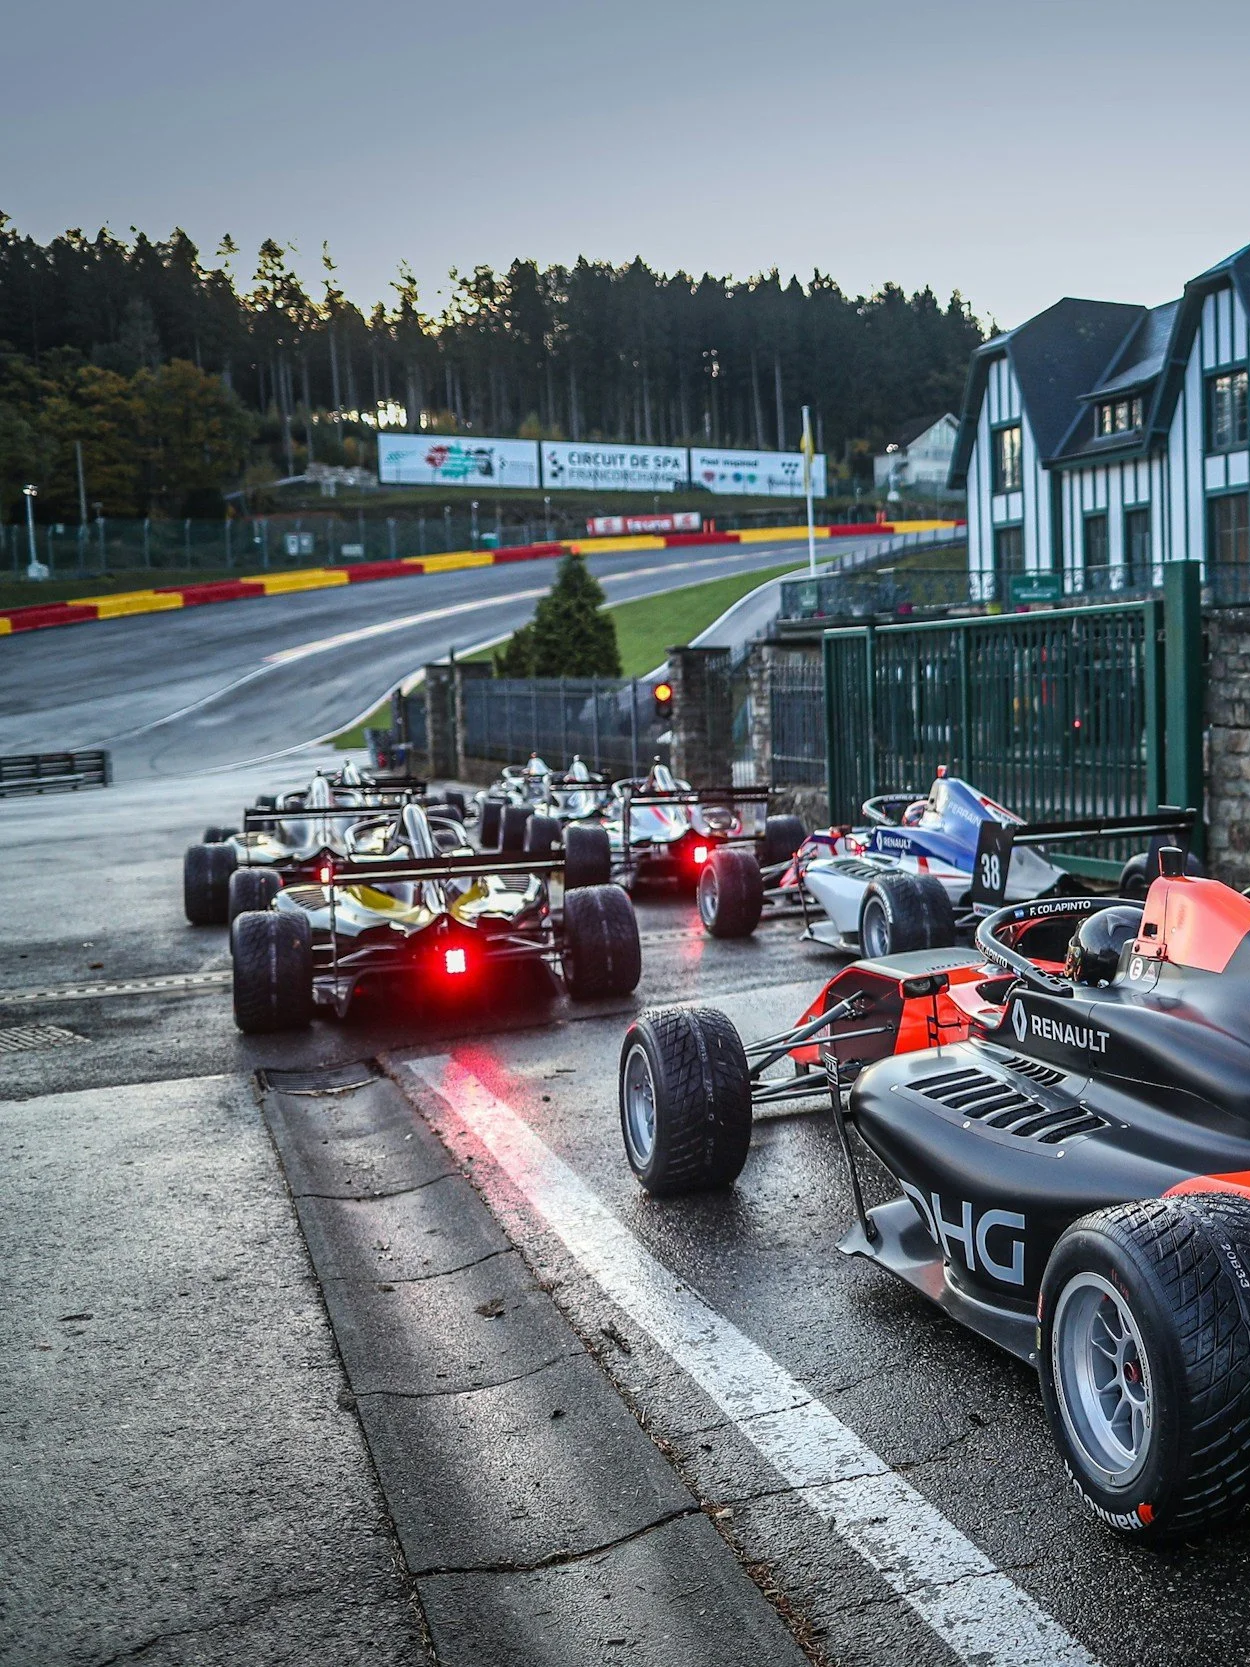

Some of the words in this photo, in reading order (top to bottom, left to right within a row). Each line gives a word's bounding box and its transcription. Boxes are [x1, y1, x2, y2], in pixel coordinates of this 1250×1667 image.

[568, 451, 626, 468] CIRCUIT
[630, 454, 650, 468] DE
[653, 455, 681, 470] SPA
[884, 836, 912, 850] RENAULT
[980, 852, 1001, 891] 38
[1029, 906, 1037, 917] F.
[1037, 900, 1091, 915] COLAPINTO
[1031, 1014, 1110, 1054] RENAULT
